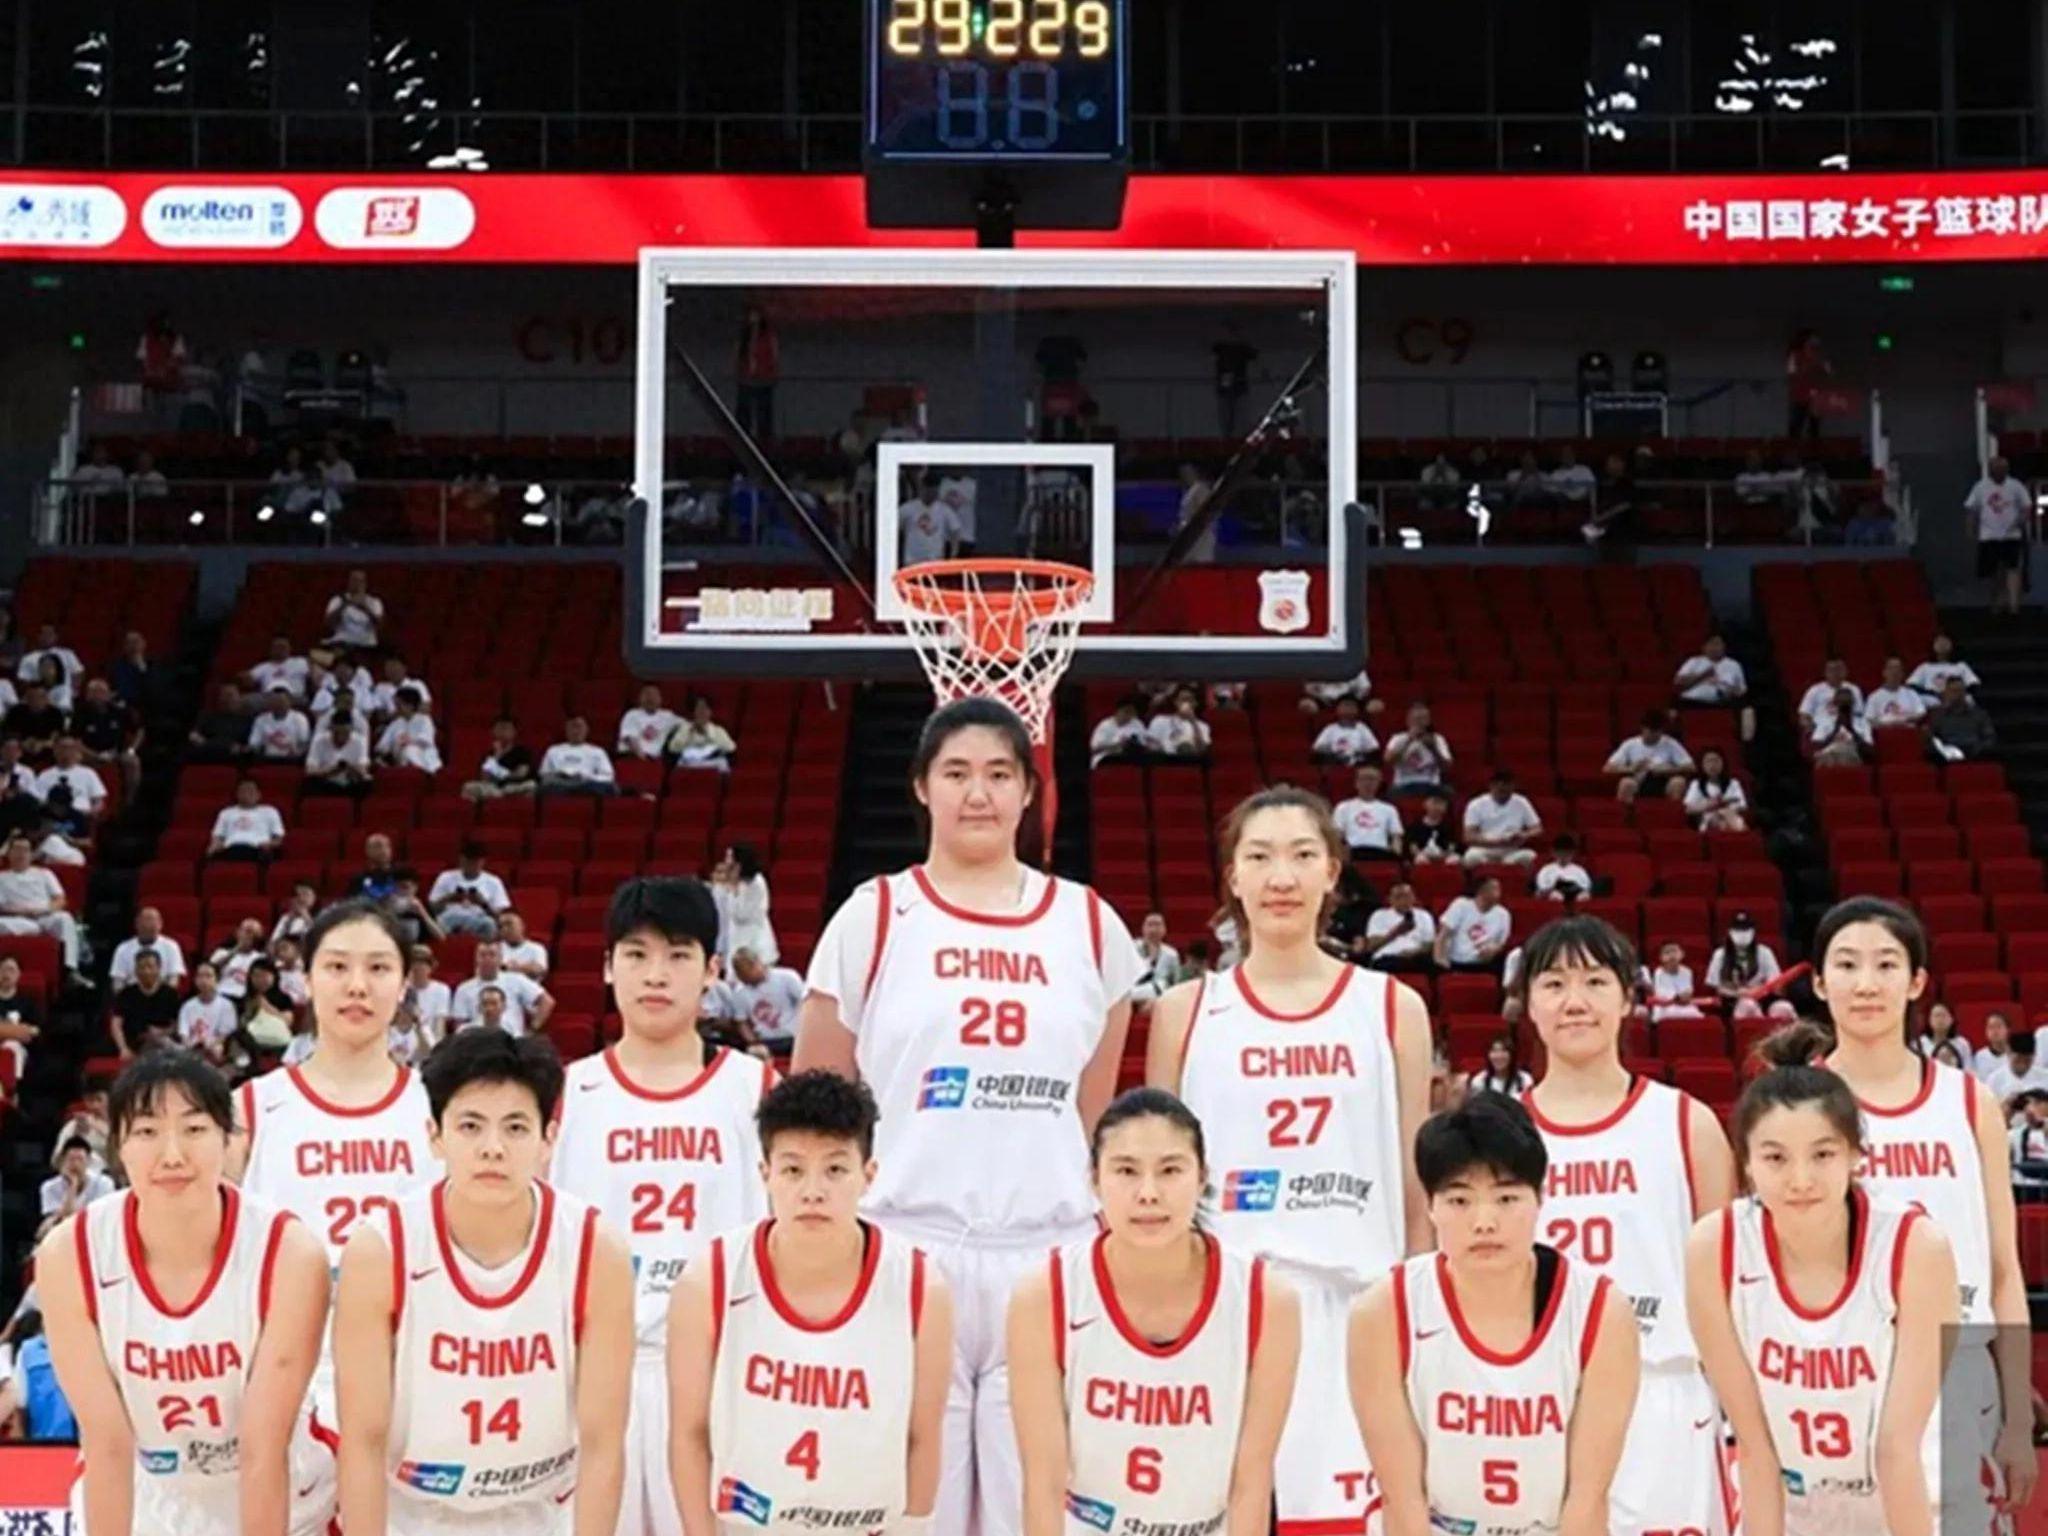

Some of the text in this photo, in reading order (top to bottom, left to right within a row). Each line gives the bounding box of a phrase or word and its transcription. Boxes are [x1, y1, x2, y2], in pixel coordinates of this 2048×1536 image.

[160, 200, 254, 222] molten
[1684, 194, 2048, 240] 中国国家女子篮球队
[517, 315, 627, 365] C10
[1395, 317, 1475, 366] C9
[934, 948, 1048, 986] CHINA
[960, 997, 1027, 1047] 28
[1240, 1044, 1356, 1078] CHINA
[607, 1126, 722, 1165] CHINA
[1266, 1096, 1333, 1148] 27
[296, 1139, 413, 1177] CHINA
[1547, 1158, 1638, 1197] HINA
[631, 1182, 697, 1234] 24
[123, 1340, 243, 1384] CHINA
[430, 1331, 557, 1378] CHINA
[1757, 1336, 1877, 1390] CHINA
[744, 1353, 871, 1410] CHINA
[1085, 1376, 1213, 1427] CHINA
[157, 1393, 224, 1433] 21
[462, 1397, 523, 1447] 14
[1436, 1391, 1564, 1438] CHINA
[1789, 1407, 1854, 1460] 13
[785, 1430, 821, 1482] 4
[1125, 1445, 1164, 1496] 6
[1481, 1458, 1521, 1507] 5
